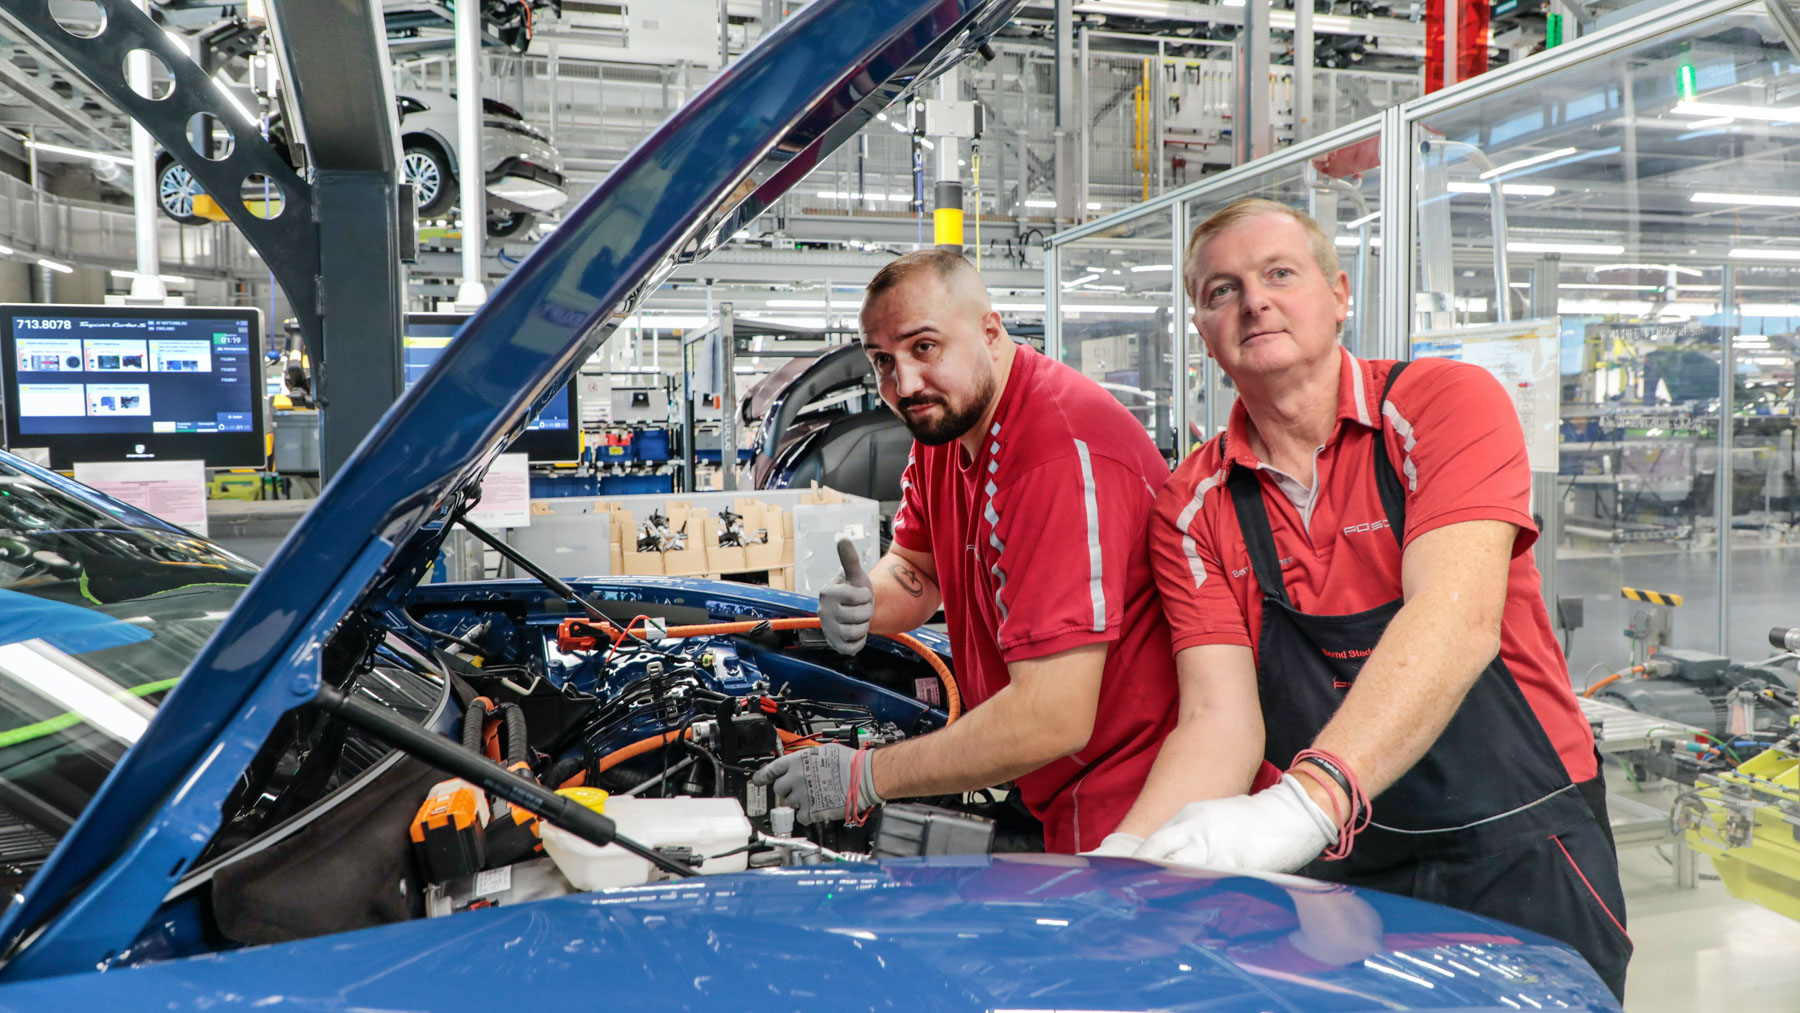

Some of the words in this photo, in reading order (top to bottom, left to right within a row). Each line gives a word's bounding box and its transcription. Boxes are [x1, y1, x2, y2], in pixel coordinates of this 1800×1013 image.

[17, 320, 71, 329] 713.8078
[220, 336, 241, 344] 01:19
[740, 339, 748, 349] 2
